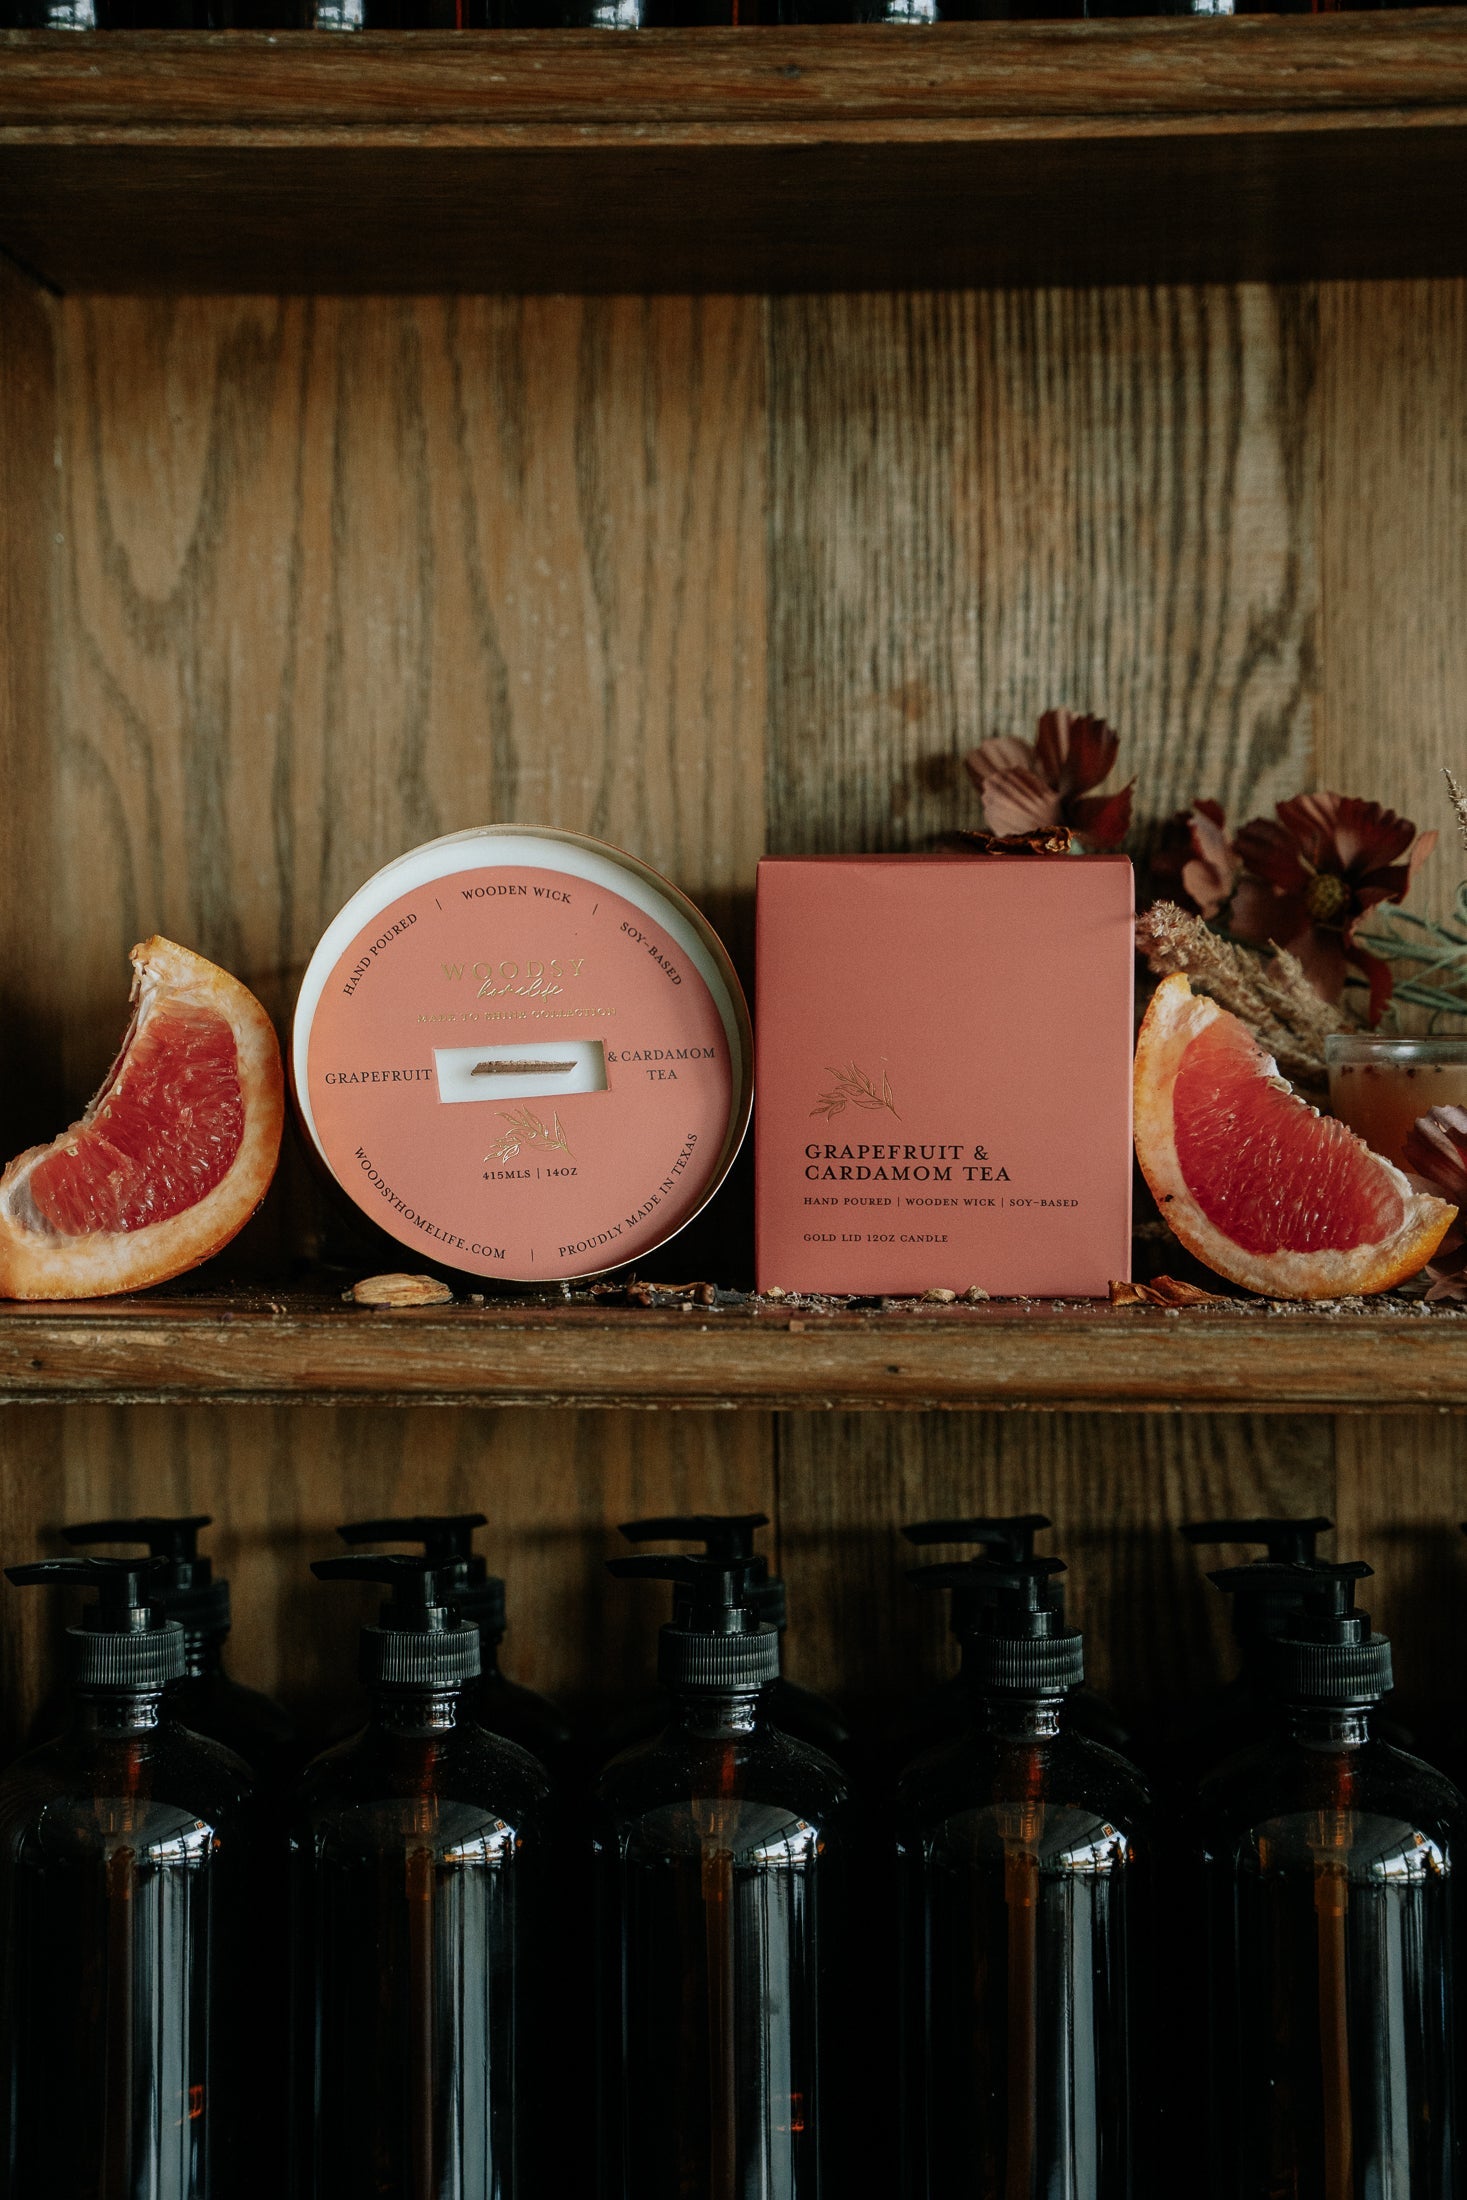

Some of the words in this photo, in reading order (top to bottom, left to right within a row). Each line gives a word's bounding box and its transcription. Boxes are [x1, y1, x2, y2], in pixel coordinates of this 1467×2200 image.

[342, 957, 371, 996] HAND
[369, 913, 418, 958] POURED
[460, 885, 528, 900] WOODEN
[533, 886, 572, 904] WICK
[620, 921, 682, 986] SOY-BASED
[440, 958, 585, 981] WOODSY
[416, 1013, 458, 1024] MADE
[460, 1012, 480, 1022] TO
[483, 1010, 529, 1021] SHINE
[531, 1007, 617, 1019] COLLECTION
[607, 1051, 619, 1063] &
[620, 1047, 716, 1062] CARDAMOM
[324, 1068, 433, 1084] GRAPEFRUIT
[646, 1069, 678, 1081] TEA
[804, 1143, 965, 1161] GRAPEFRUIT
[973, 1144, 990, 1161] &
[482, 1169, 531, 1181] 415MLS
[546, 1166, 579, 1179] 14OZ
[804, 1165, 953, 1182] CARDAMOM
[963, 1165, 1012, 1182] TEA
[354, 1147, 508, 1261] WOODSYHOMELIFE.COM
[557, 1224, 626, 1258] PROUDLY
[625, 1195, 661, 1229] MADE
[659, 1177, 676, 1196] IN
[671, 1132, 699, 1177] TEXAS
[803, 1196, 839, 1206] HAND
[843, 1196, 892, 1206] POURED
[905, 1197, 960, 1207] WOODEN
[963, 1197, 996, 1207] WICK
[1009, 1198, 1080, 1208] SOY-BASED
[803, 1233, 837, 1243] GOLD
[841, 1233, 863, 1243] LID
[866, 1233, 897, 1243] 12OZ
[899, 1233, 949, 1243] CANDLE
